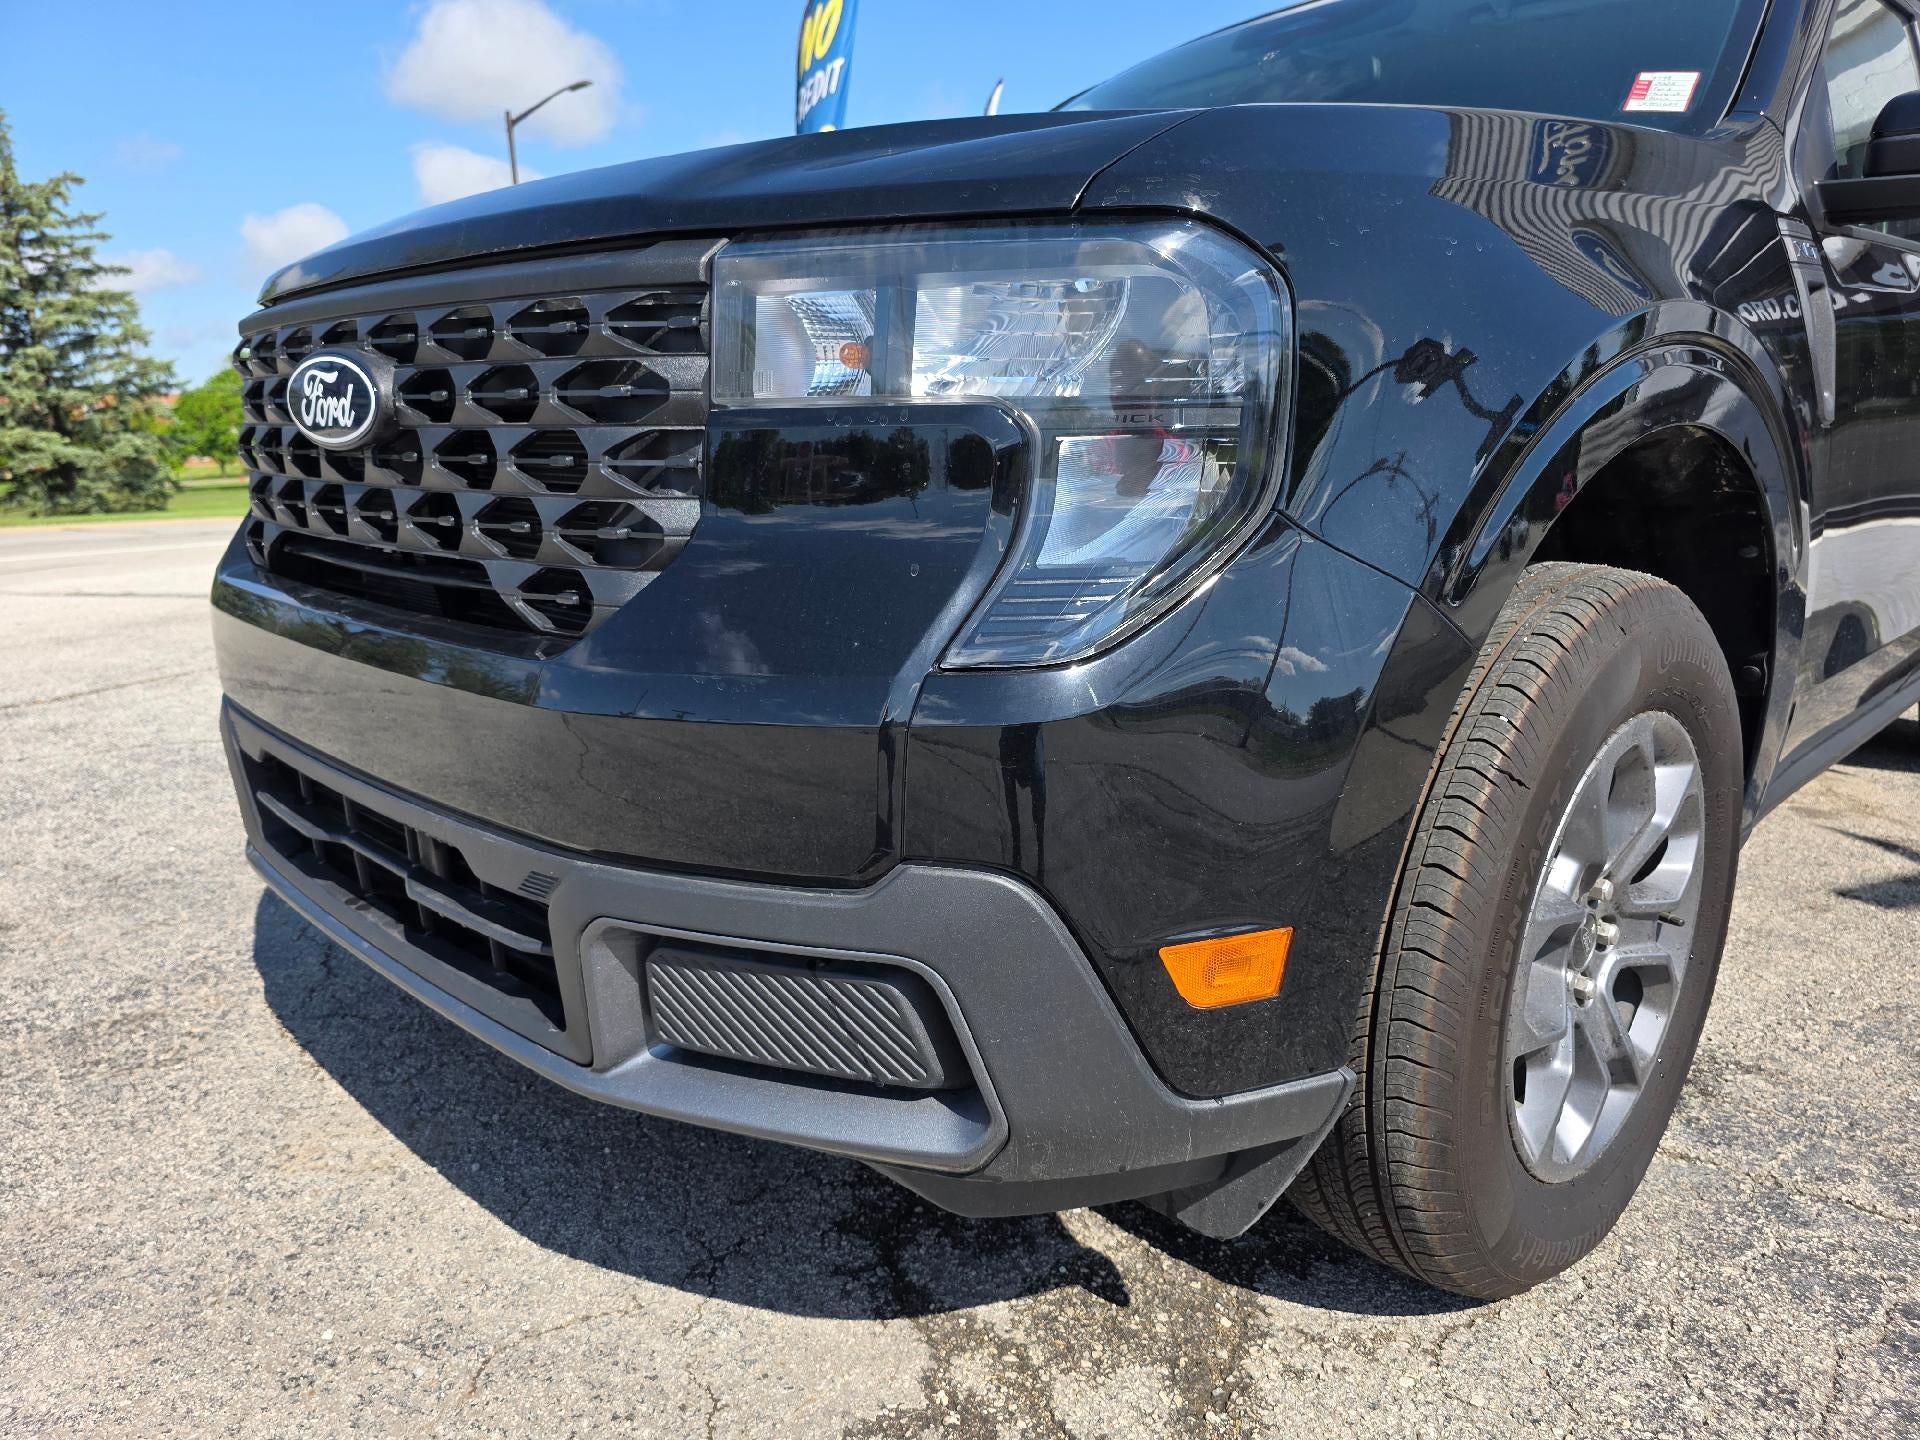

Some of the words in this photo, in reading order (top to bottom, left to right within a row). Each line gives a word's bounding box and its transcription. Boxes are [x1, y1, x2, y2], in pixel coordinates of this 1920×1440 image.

[800, 0, 844, 77] NO
[1736, 294, 1801, 323] ORD.C
[301, 369, 355, 428] Ford
